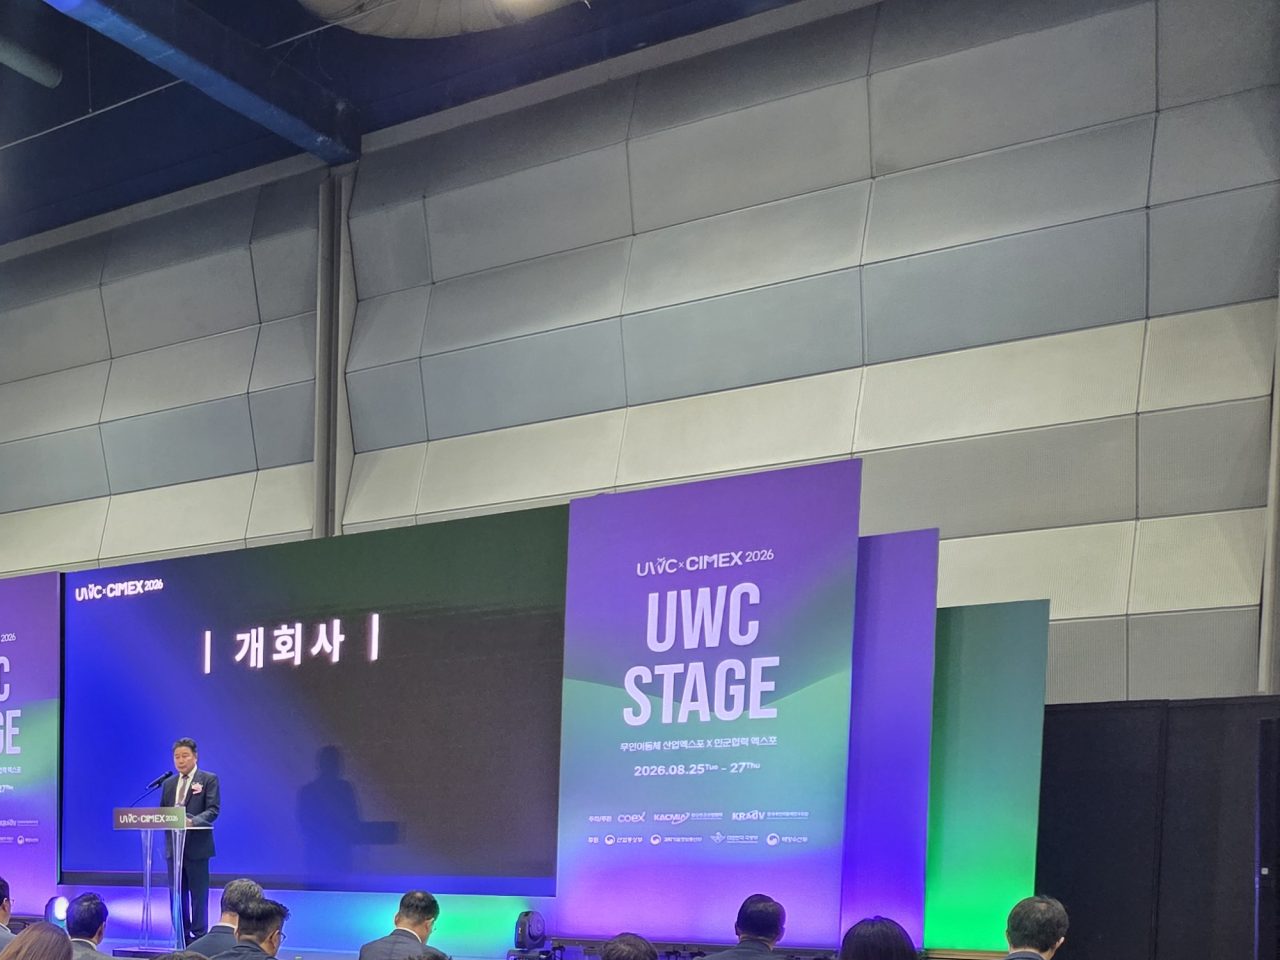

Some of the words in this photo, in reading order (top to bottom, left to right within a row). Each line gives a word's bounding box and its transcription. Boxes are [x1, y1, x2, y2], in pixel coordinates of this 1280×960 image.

[686, 551, 743, 571] CIMEX
[745, 549, 775, 562] 2026
[107, 580, 144, 597] CIMEX
[144, 579, 164, 591] 2026
[647, 582, 760, 653] UWC
[234, 618, 345, 669] 개회사
[623, 656, 780, 726] STAGE
